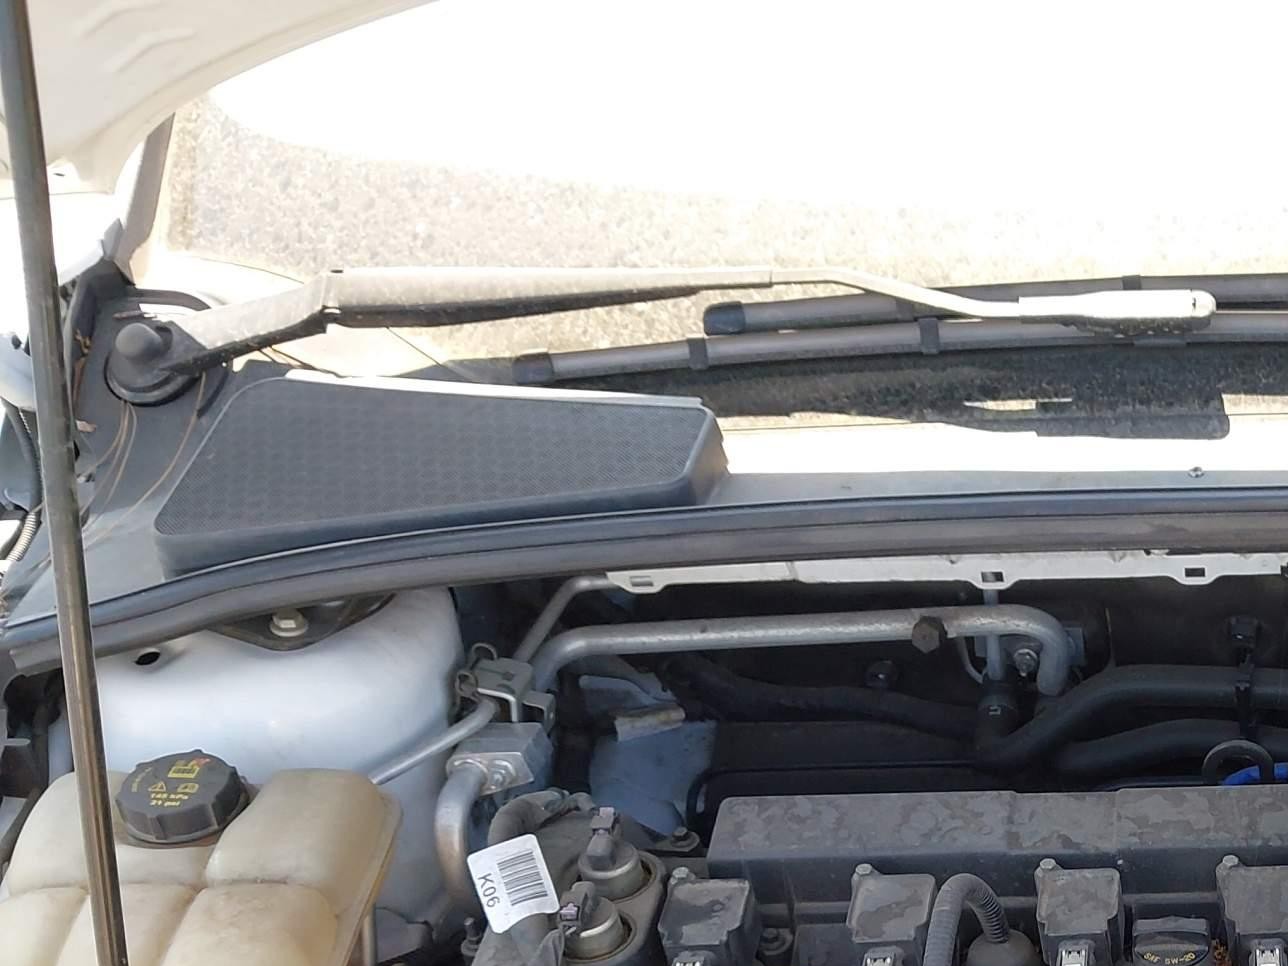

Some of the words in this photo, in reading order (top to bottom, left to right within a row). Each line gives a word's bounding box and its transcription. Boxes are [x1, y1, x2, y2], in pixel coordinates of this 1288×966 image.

[477, 872, 501, 908] K06
[1143, 952, 1160, 964] SAE
[1164, 952, 1196, 965] 5W-20
